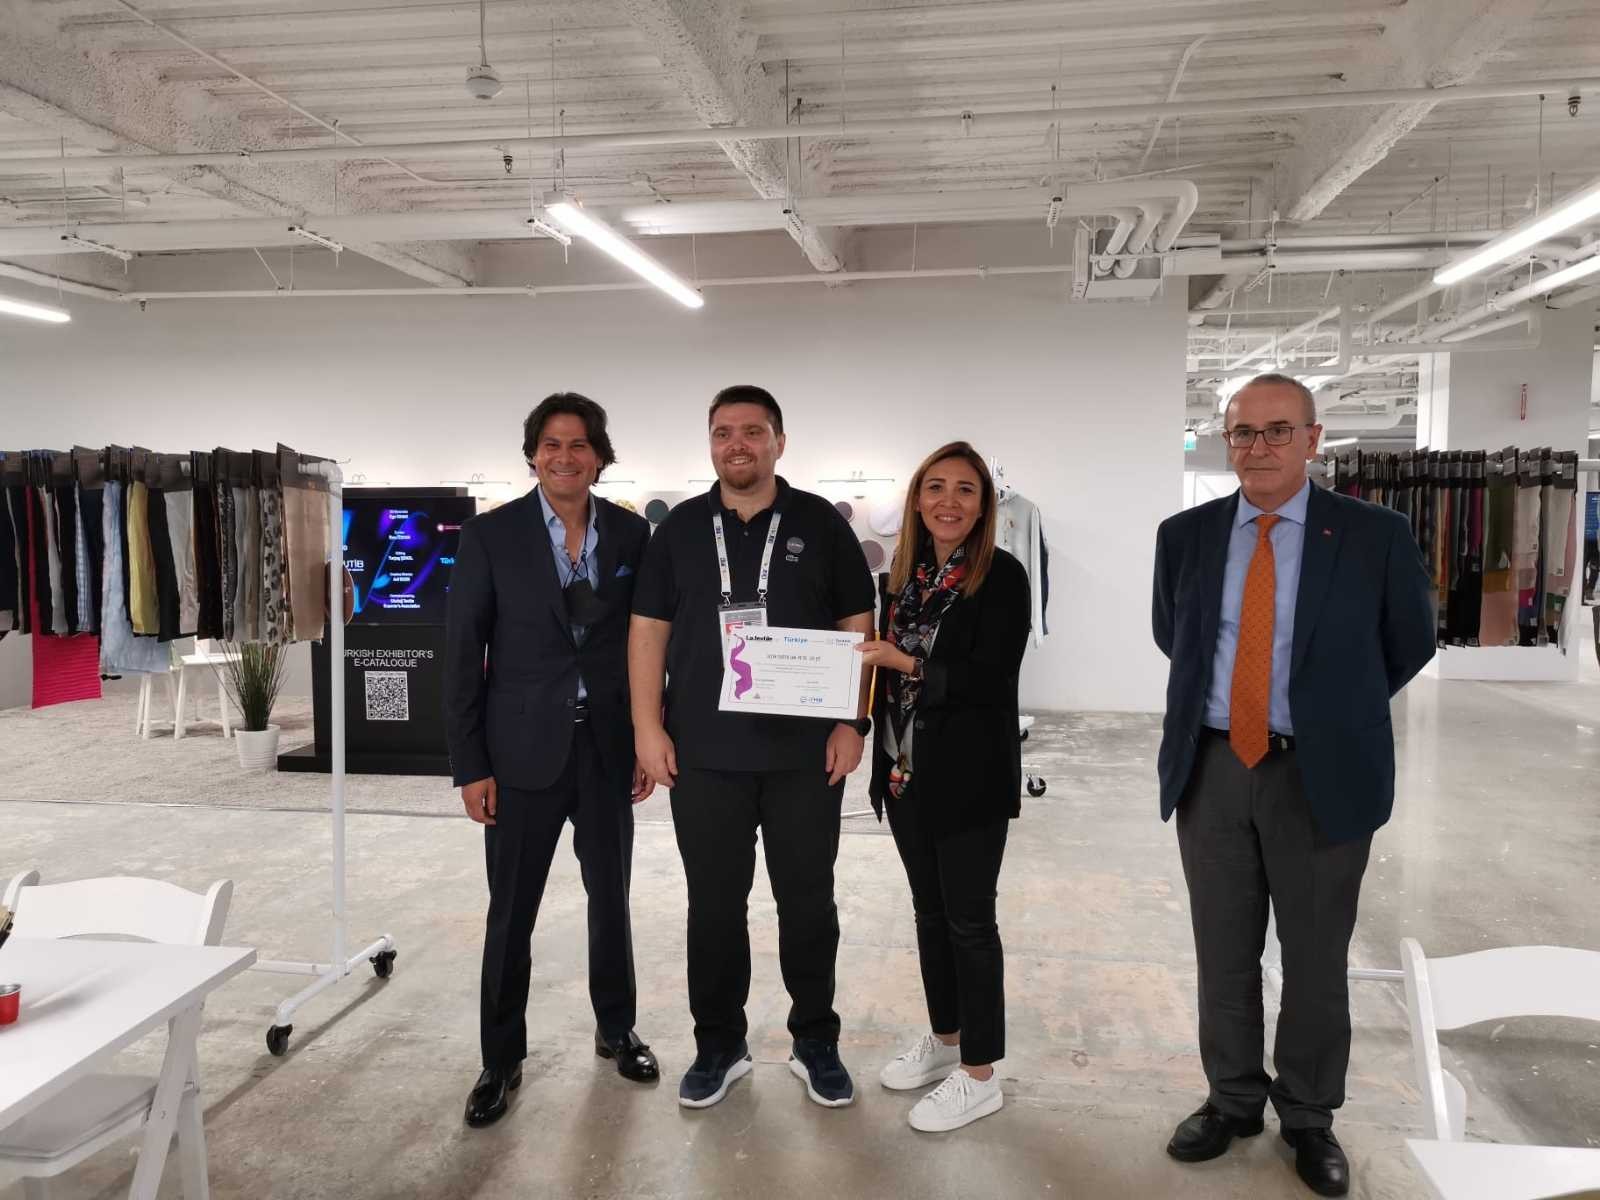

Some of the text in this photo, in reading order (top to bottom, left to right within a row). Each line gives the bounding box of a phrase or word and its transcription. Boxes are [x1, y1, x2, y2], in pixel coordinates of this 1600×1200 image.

[344, 649, 434, 659] URKISH EXHIBITOR'S
[354, 658, 418, 667] E-CATALOGUE
